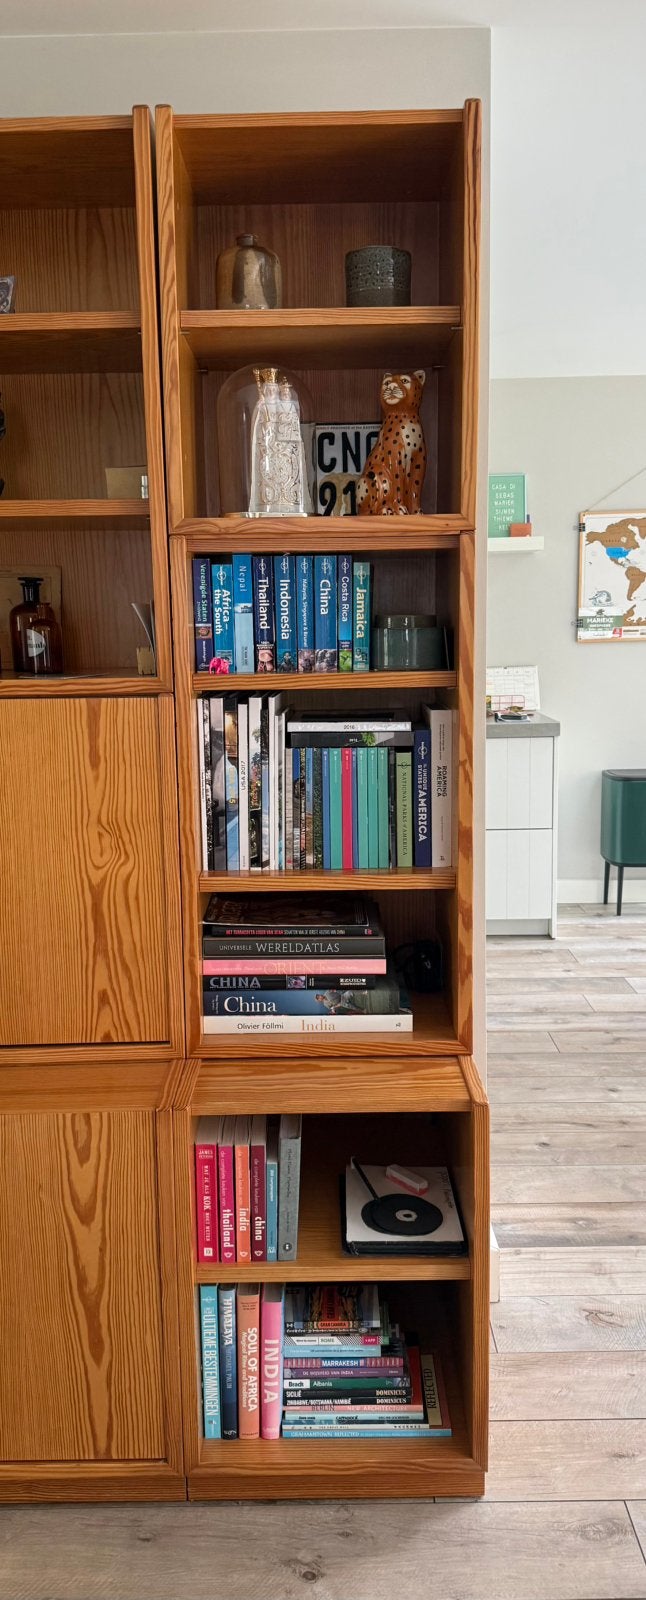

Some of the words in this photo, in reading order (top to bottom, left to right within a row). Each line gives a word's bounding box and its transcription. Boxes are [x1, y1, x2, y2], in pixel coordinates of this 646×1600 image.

[199, 564, 208, 599] Verenigde
[238, 565, 247, 592] Nepal
[341, 576, 349, 602] Costa
[214, 589, 222, 605] the
[222, 589, 232, 622] Africa
[258, 576, 271, 630] Thailand
[279, 579, 292, 640] Indonesia
[319, 579, 331, 615] China
[214, 607, 222, 635] South
[341, 603, 349, 622] Rica
[356, 587, 367, 638] Jamaica
[417, 789, 428, 842] AMERICA
[255, 942, 340, 953] WERELDATLAS
[263, 961, 326, 974] ORIENT
[209, 976, 261, 988] CHINA
[223, 996, 277, 1013] China
[237, 1022, 260, 1030] Olivier
[262, 1021, 284, 1030] Föllmi
[301, 1019, 336, 1031] India
[203, 1195, 211, 1210] KOK
[222, 1209, 234, 1248] thailand
[239, 1208, 249, 1231] india
[254, 1216, 266, 1241] china
[203, 1314, 217, 1349] ULTIEME
[222, 1296, 233, 1346] HIMALAYA
[240, 1331, 248, 1354] Magical
[247, 1327, 258, 1356] SOUL
[247, 1358, 258, 1372] OF
[264, 1338, 279, 1404] INDIA
[321, 1359, 359, 1367] MARRAKESH
[204, 1350, 219, 1416] BESTEMMINGEN
[247, 1375, 258, 1412] AFRICA
[423, 1368, 437, 1408] REFLECTED
